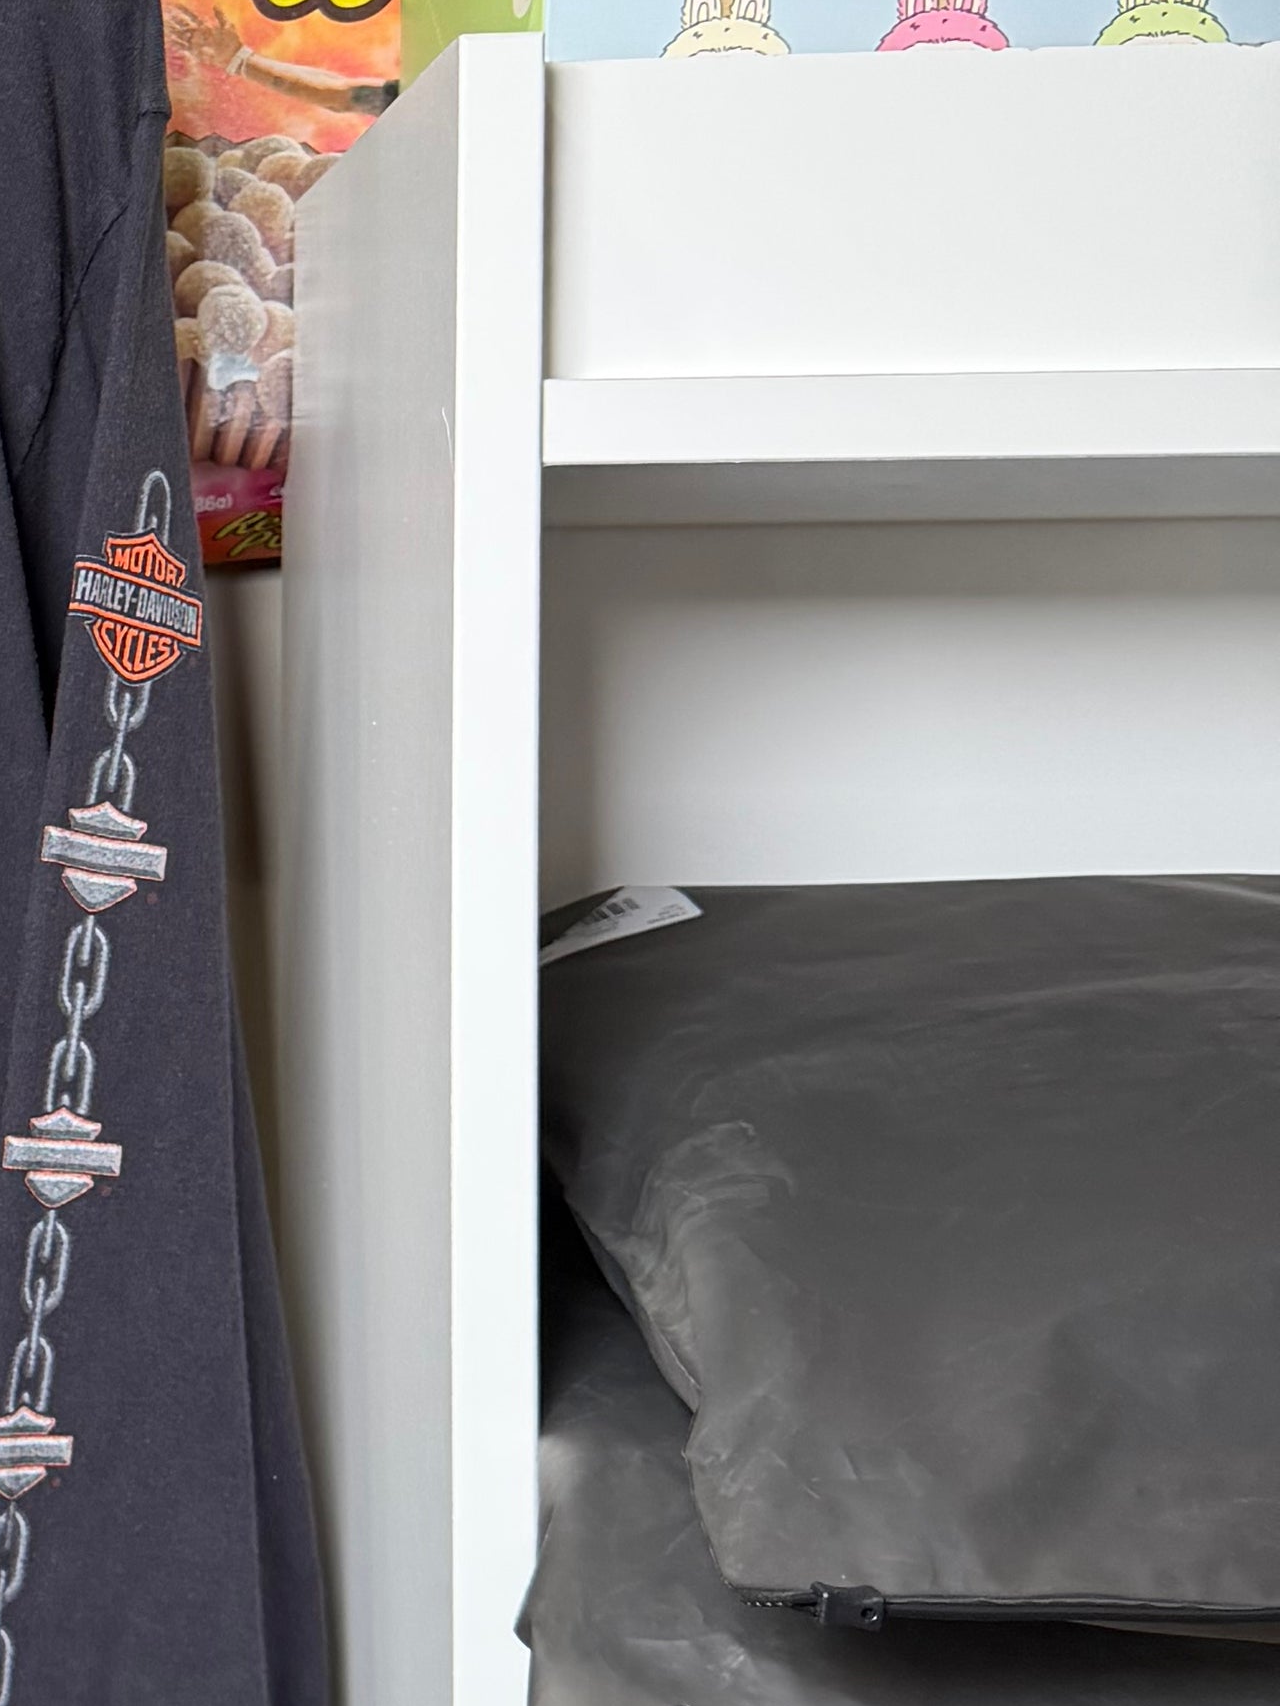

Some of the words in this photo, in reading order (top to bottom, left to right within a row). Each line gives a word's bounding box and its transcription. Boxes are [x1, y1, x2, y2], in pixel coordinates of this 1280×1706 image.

[114, 544, 179, 587] MOTOR
[75, 569, 197, 635] HARLEY-DAVIDSON
[106, 622, 171, 672] CYCLES
